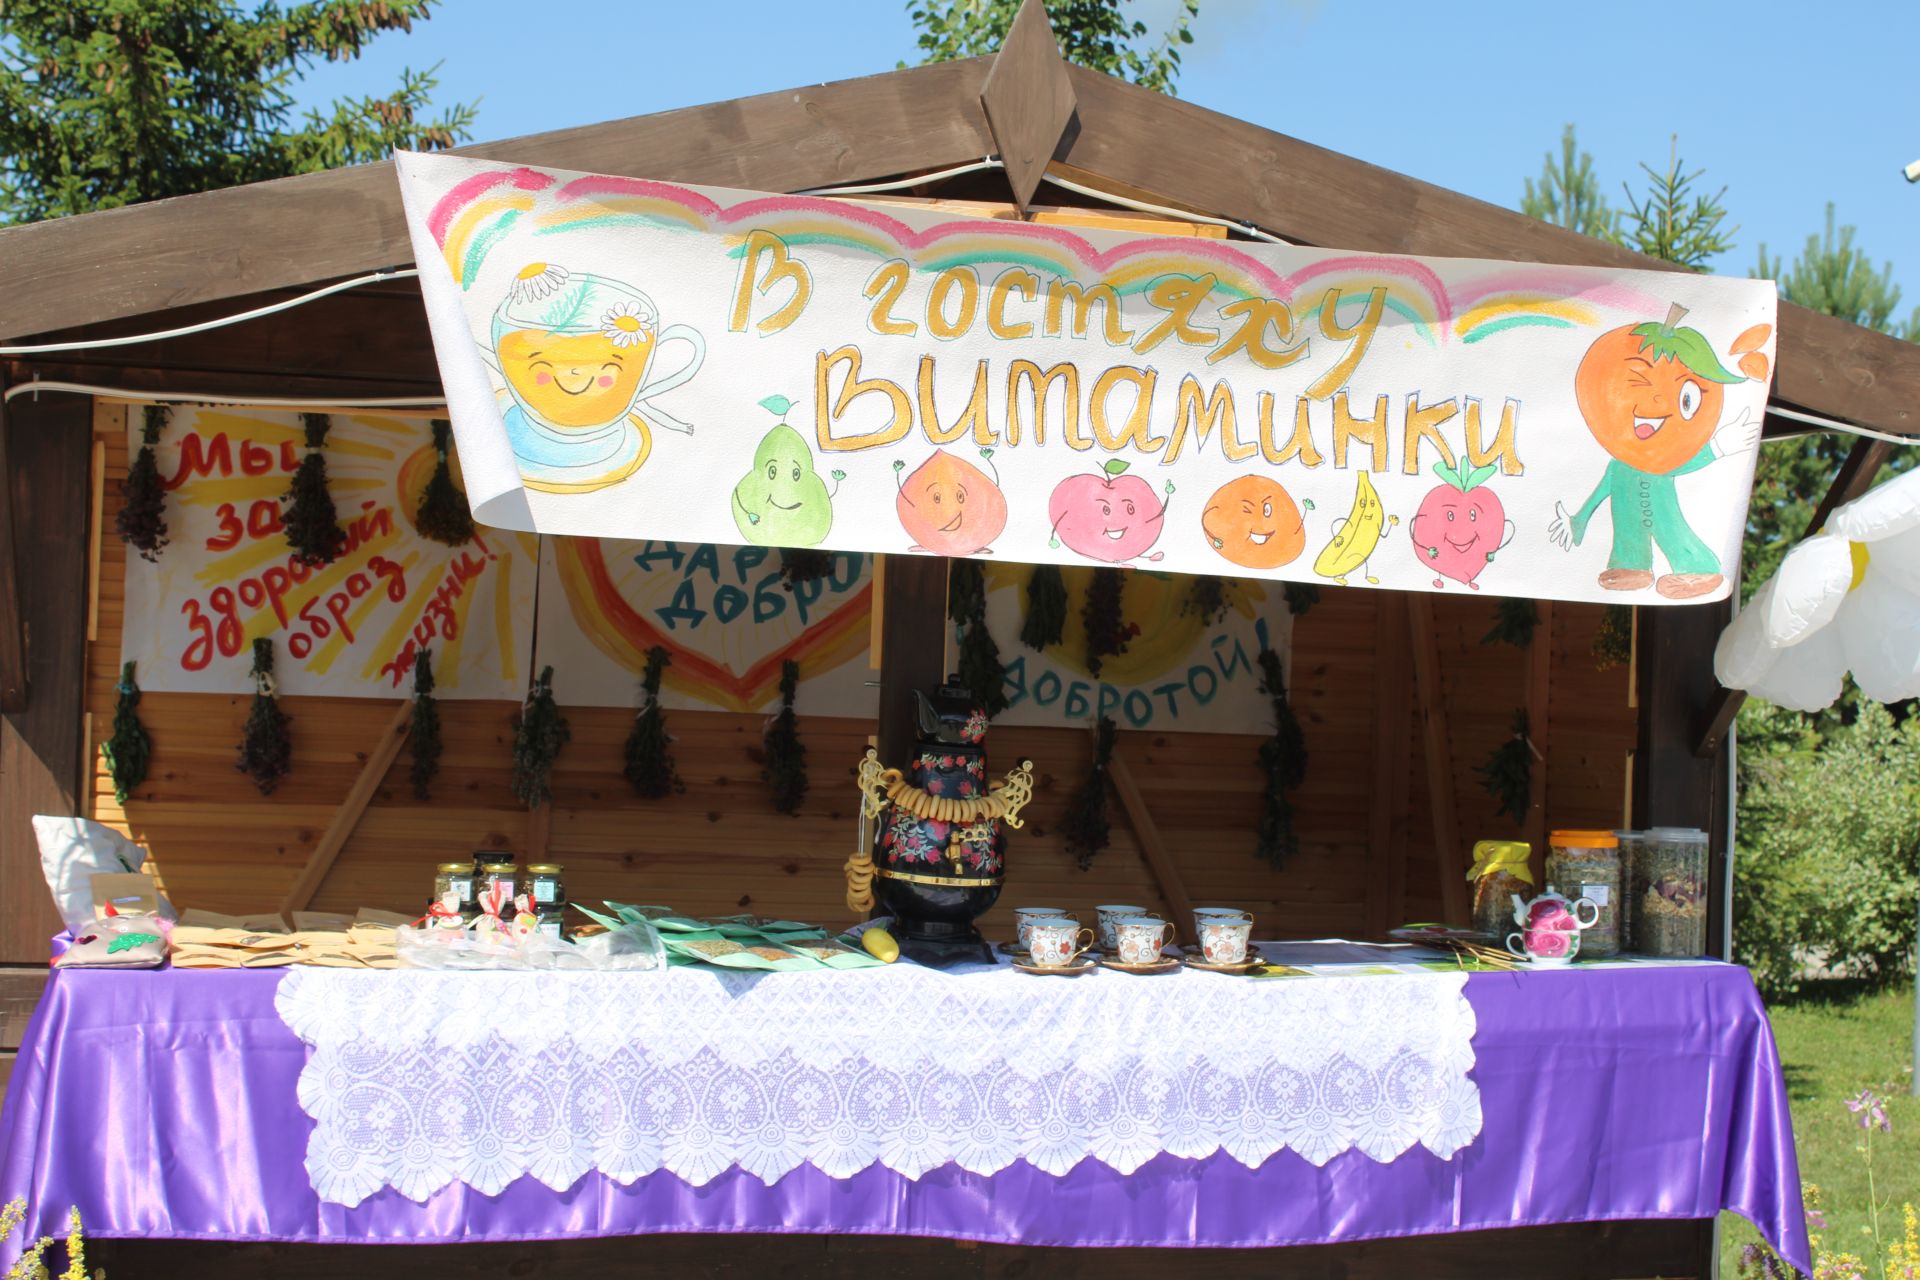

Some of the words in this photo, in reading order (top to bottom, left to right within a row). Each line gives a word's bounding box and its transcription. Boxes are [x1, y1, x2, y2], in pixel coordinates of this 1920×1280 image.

[728, 229, 814, 338] В
[862, 257, 1310, 369] гостях
[1304, 285, 1388, 401] у
[814, 344, 1525, 477] Витаминки
[181, 500, 394, 672] здороый
[206, 499, 285, 552] за
[288, 555, 406, 659] образ
